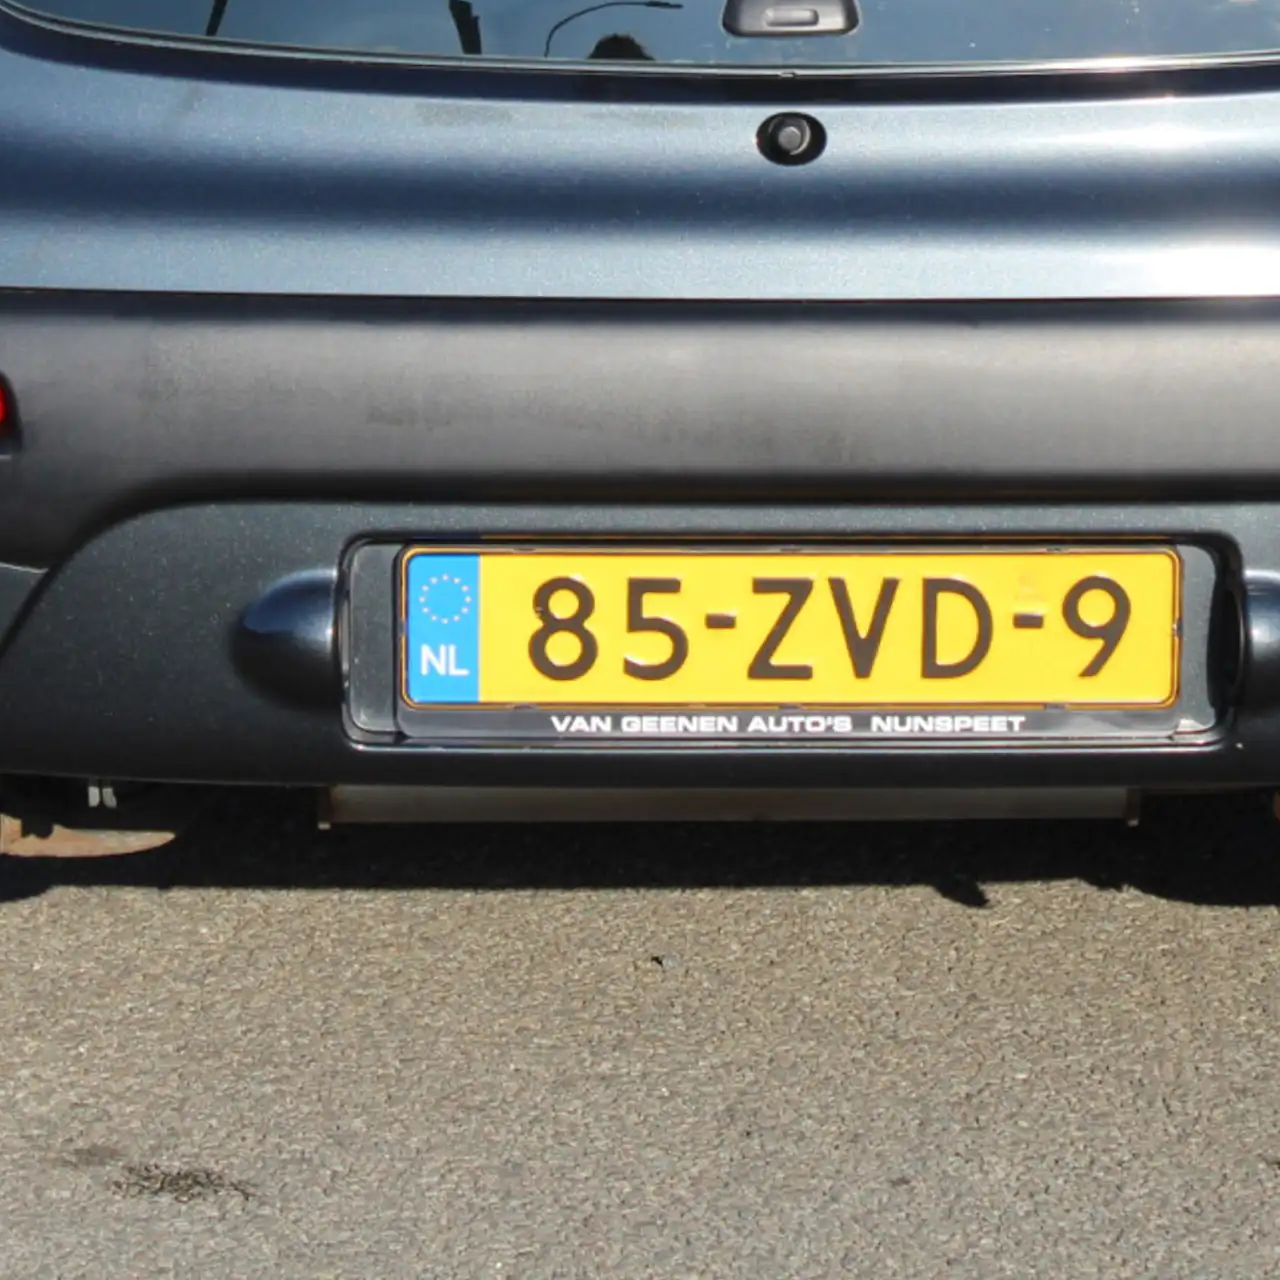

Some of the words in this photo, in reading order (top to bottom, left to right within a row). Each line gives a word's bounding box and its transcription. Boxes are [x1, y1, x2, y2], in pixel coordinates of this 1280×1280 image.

[527, 575, 1132, 681] 85-ZVD-9
[419, 643, 470, 677] NL
[551, 715, 613, 733] VAN
[620, 715, 739, 733] GEENEN
[746, 715, 853, 733] AUTO'S
[870, 715, 1027, 733] NUNSPEET
